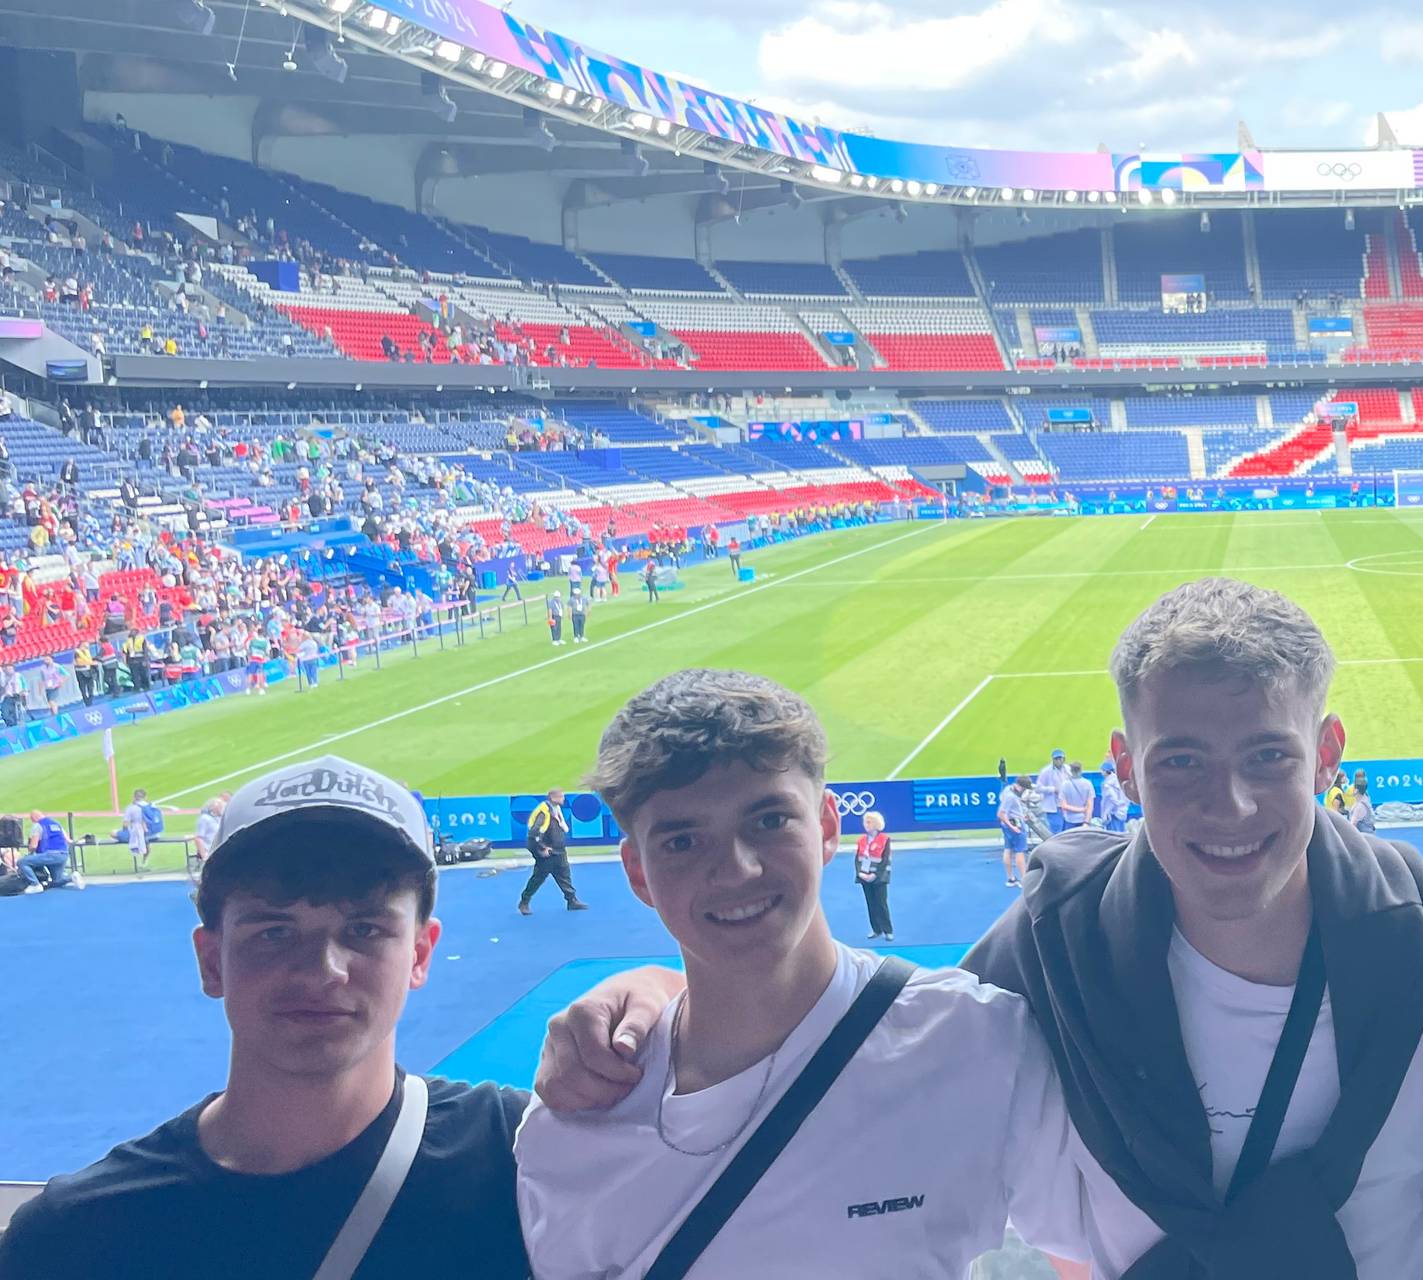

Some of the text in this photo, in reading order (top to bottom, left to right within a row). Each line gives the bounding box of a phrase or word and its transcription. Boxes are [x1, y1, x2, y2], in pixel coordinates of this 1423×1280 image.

[1376, 774, 1423, 789] 2024
[925, 792, 981, 808] PARIS
[448, 811, 501, 827] 2024
[847, 1194, 925, 1219] REVIEW
